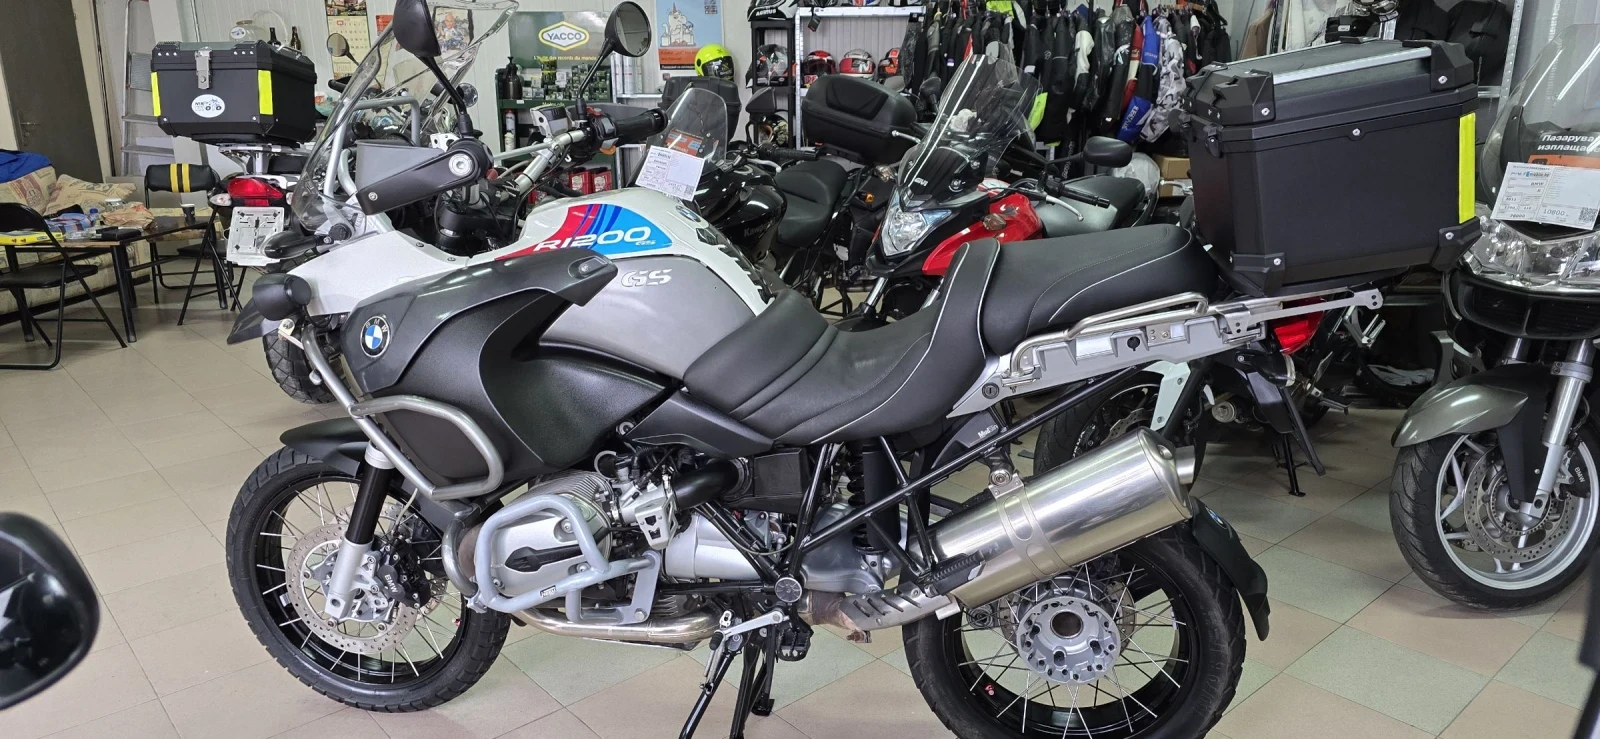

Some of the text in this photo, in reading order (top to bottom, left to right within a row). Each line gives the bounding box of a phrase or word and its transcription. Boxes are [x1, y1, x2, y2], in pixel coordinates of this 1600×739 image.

[547, 32, 582, 41] YACCO
[1543, 208, 1565, 216] 10800
[621, 268, 673, 288] GS
[365, 318, 388, 333] BMW
[1574, 466, 1586, 483] BMW
[384, 573, 399, 593] BMW
